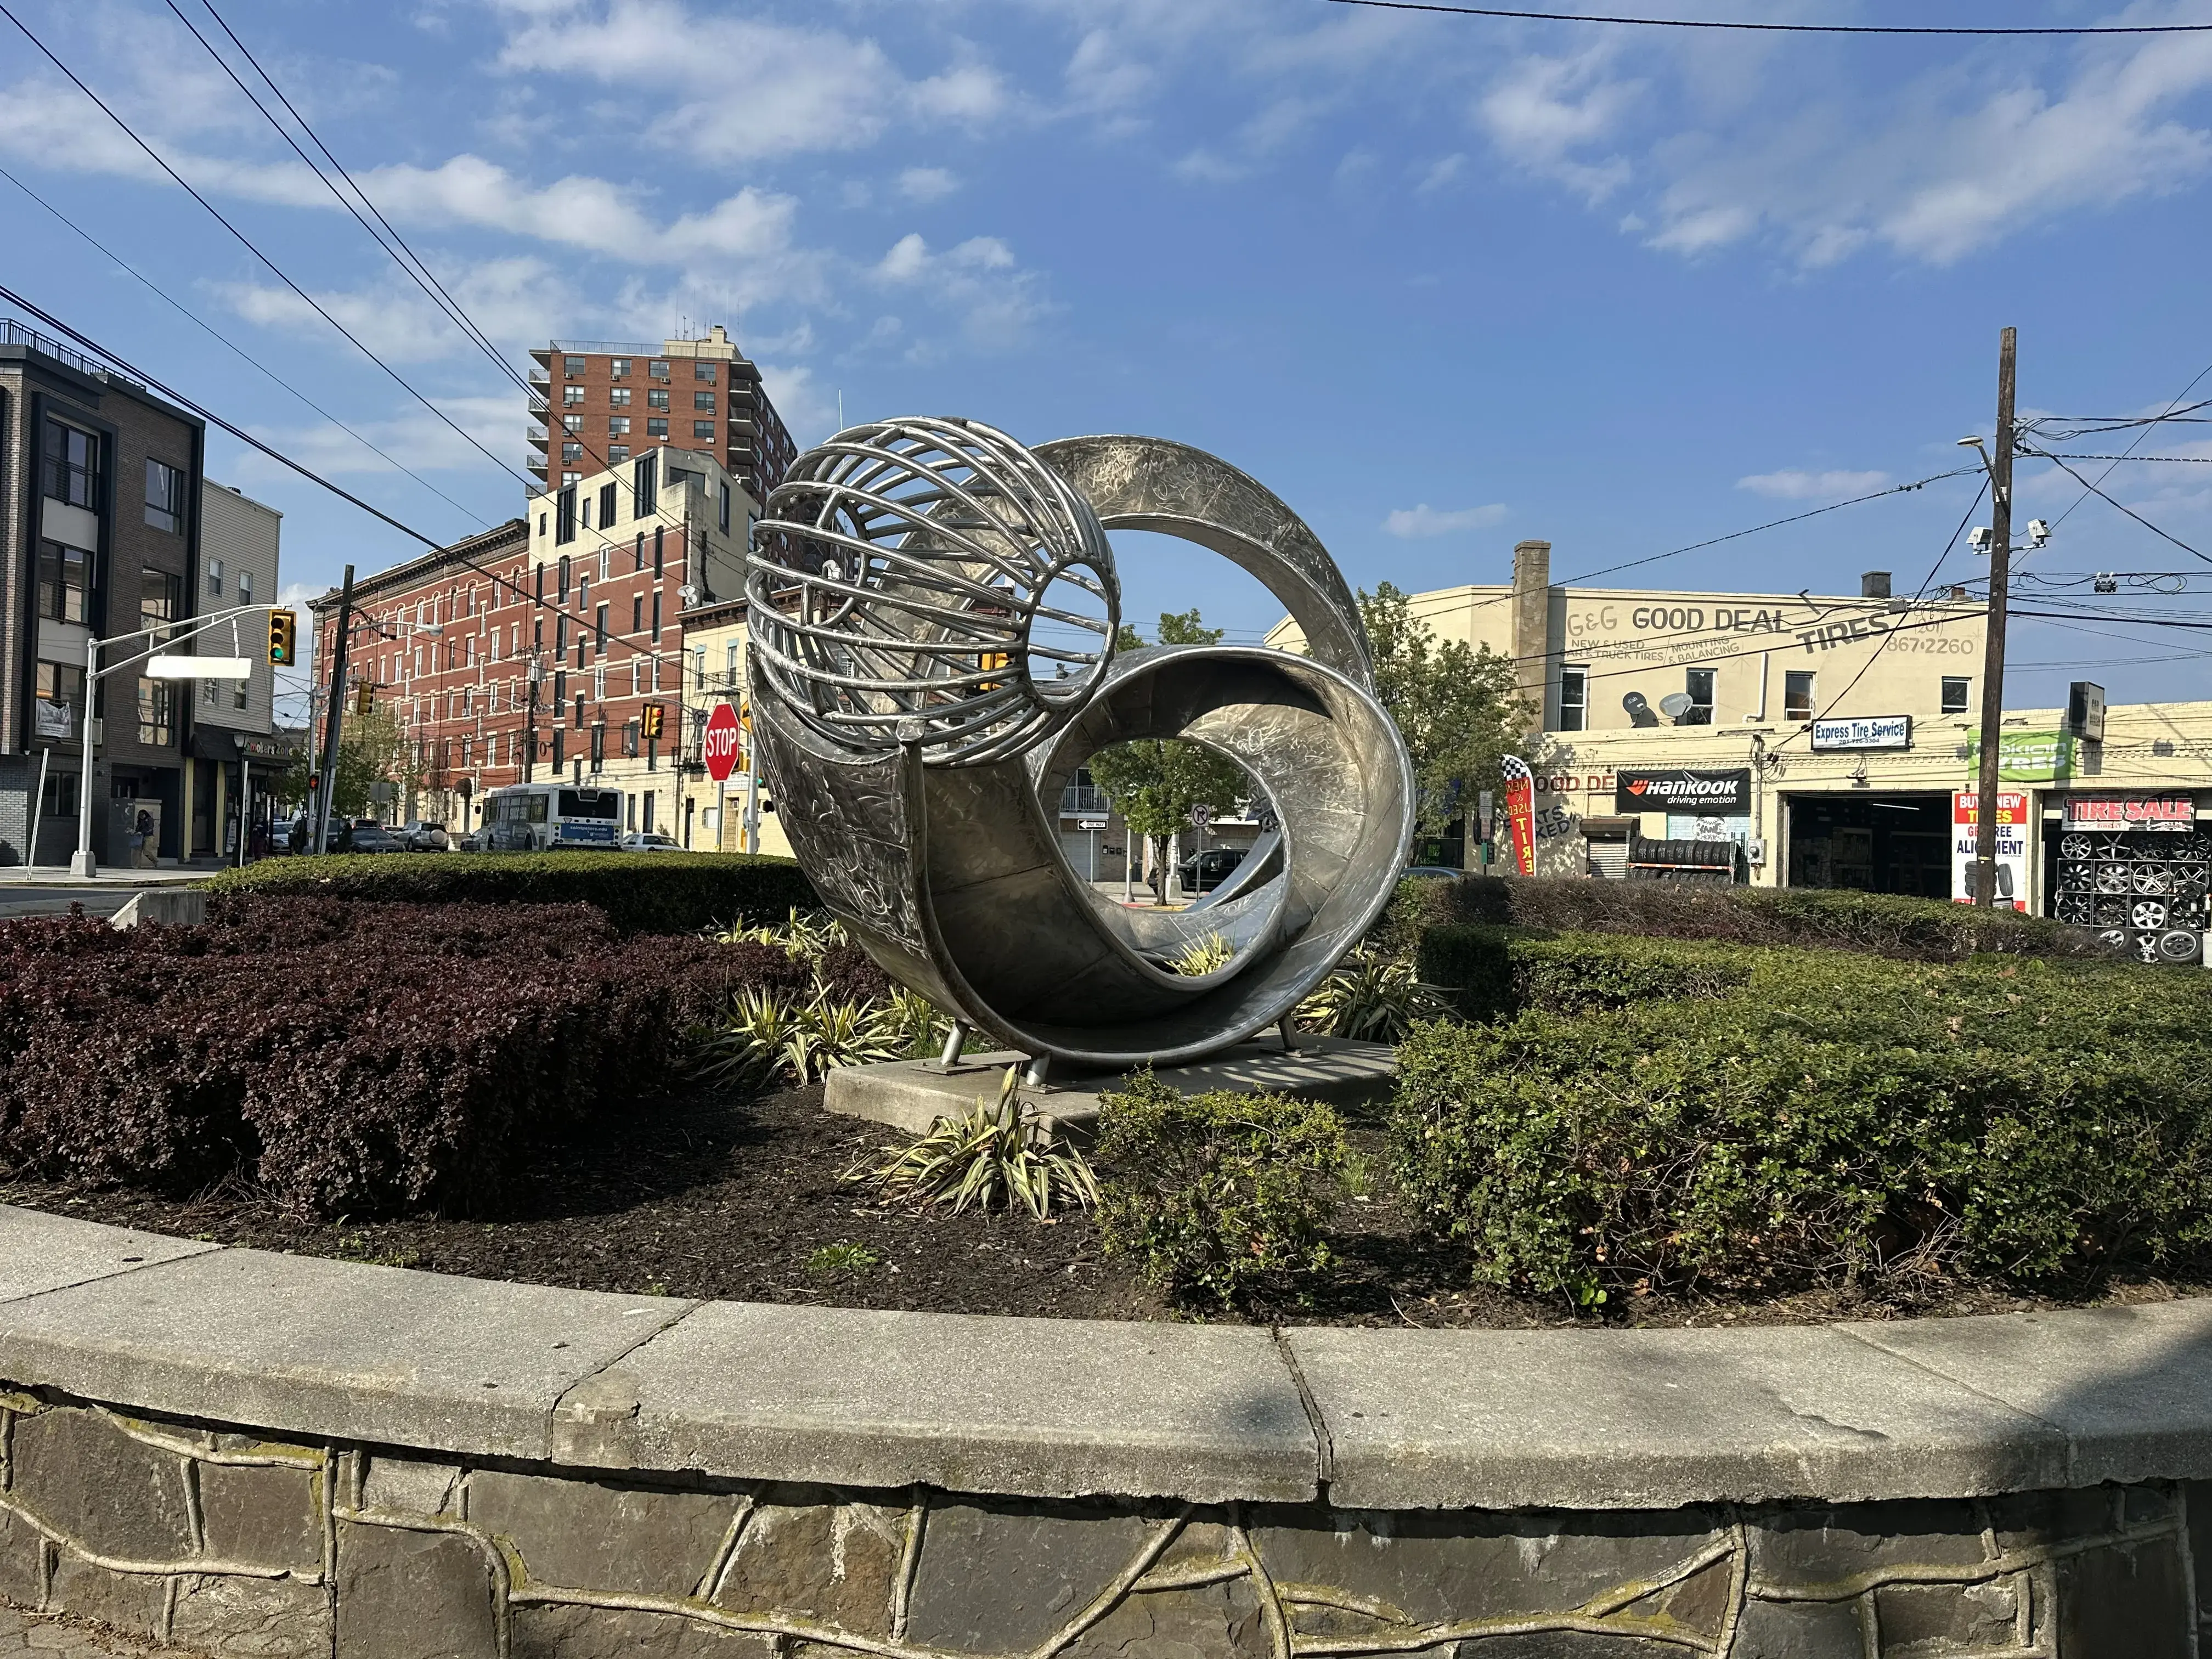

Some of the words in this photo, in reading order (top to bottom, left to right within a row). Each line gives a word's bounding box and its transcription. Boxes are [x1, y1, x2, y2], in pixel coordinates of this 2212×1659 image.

[1567, 606, 1617, 636] G&G
[1632, 607, 1704, 630] GOOD
[1715, 609, 1792, 634] DEAL
[1915, 616, 1944, 637] (201)
[1796, 612, 1889, 654] TIRES
[1572, 639, 1600, 648] NEW
[1614, 640, 1645, 650] USED
[1669, 656, 1676, 664] &
[1678, 642, 1739, 663] BALANCING
[1671, 636, 1730, 653] MOUNTING
[1560, 648, 1583, 657] CAR
[1594, 650, 1632, 659] TRUCK
[1635, 651, 1664, 661] TIRES
[1815, 724, 1849, 742] Express
[1852, 722, 1869, 738] Tire
[1871, 720, 1905, 737] Service
[707, 727, 737, 758] STOP
[1999, 755, 2066, 770] YRES
[1534, 775, 1581, 792] OOD
[1588, 775, 1616, 791] DE
[1667, 795, 1697, 806] driving
[1996, 795, 2021, 808] NEW
[2067, 797, 2124, 821] TIRE
[2125, 797, 2192, 821] SALE
[1967, 810, 2013, 823] TES
[1995, 826, 2012, 837] REE
[1956, 840, 2023, 854] ALIMENT
